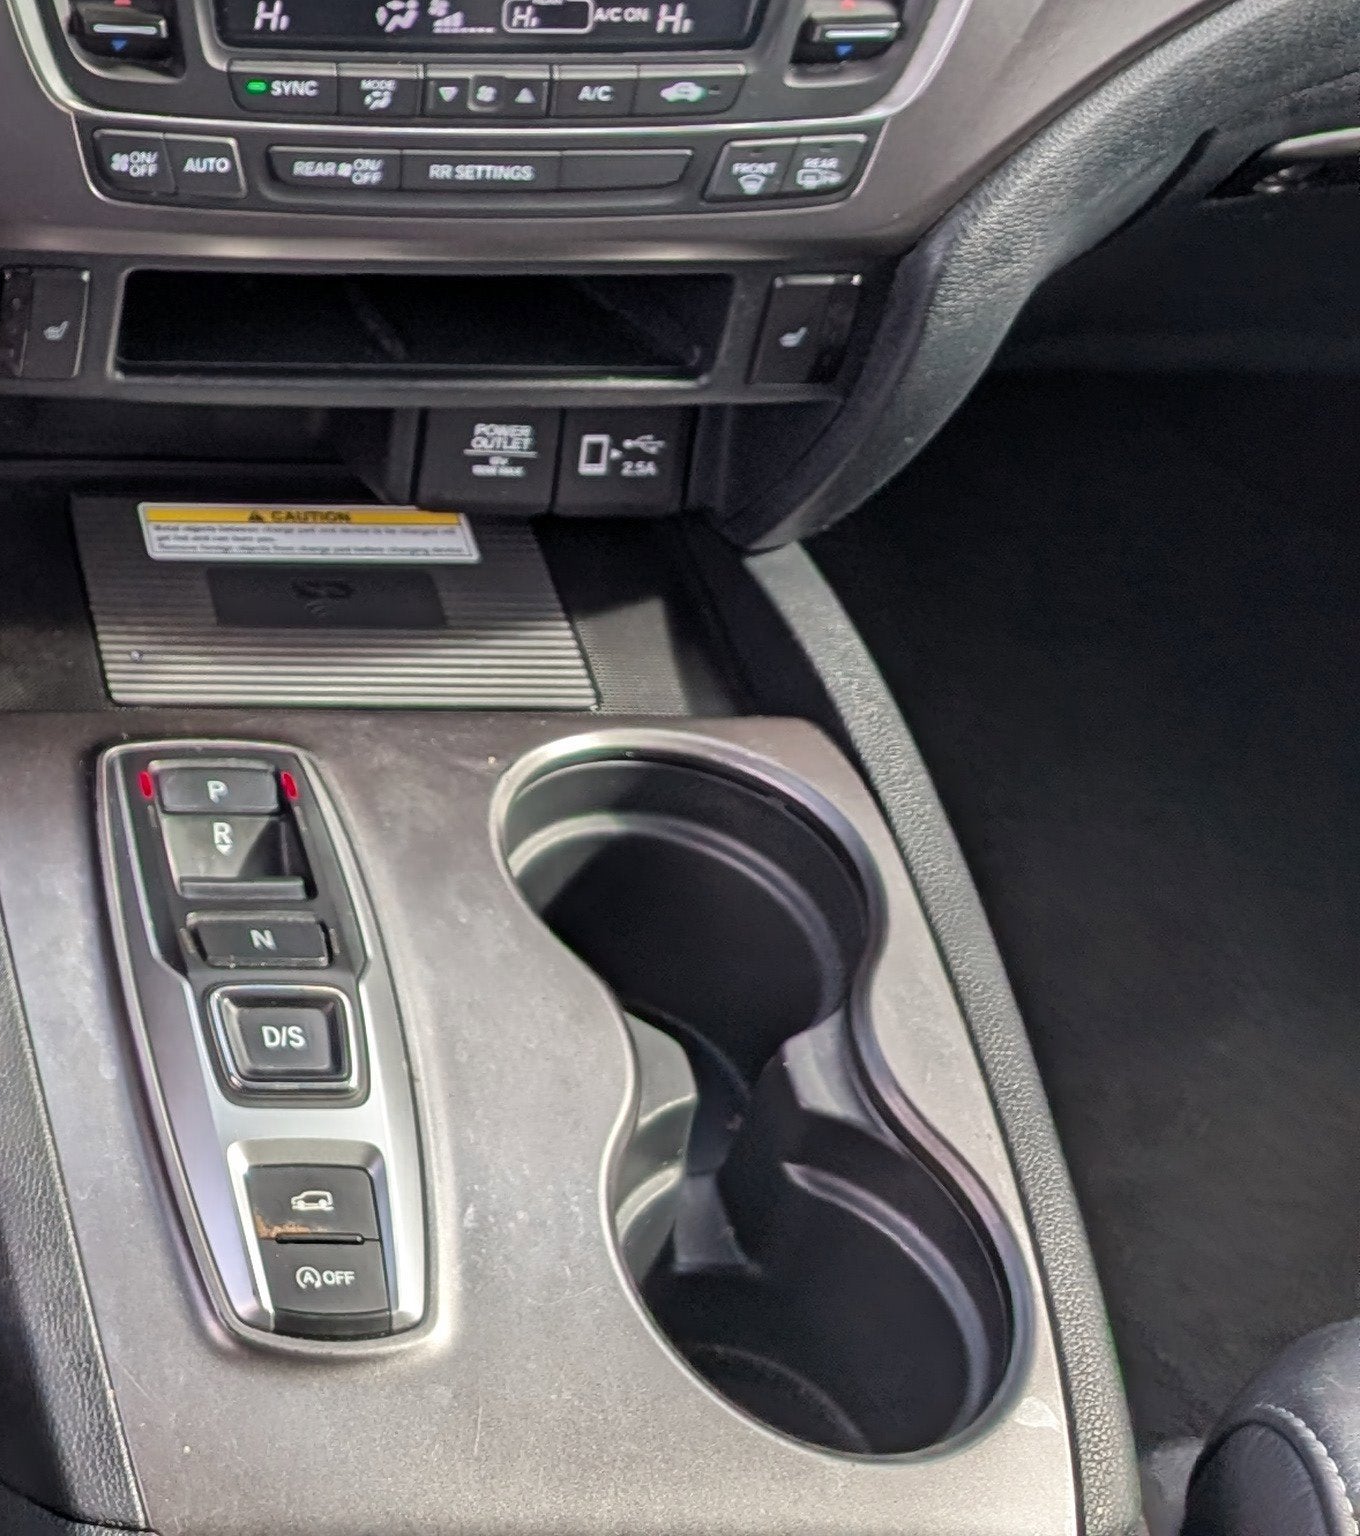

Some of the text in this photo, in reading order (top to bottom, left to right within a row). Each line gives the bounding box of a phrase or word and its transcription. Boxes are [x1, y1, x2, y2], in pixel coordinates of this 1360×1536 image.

[594, 7, 650, 22] A/C ON
[270, 79, 318, 97] SYNC
[360, 79, 398, 91] MODE
[578, 84, 614, 102] A/C
[182, 156, 230, 174] AUTO
[292, 161, 337, 177] REAR
[733, 161, 777, 175] FRONT
[803, 157, 839, 169] REAR
[129, 164, 158, 178] OFF
[351, 171, 383, 185] OFF
[428, 164, 535, 181] RR SETTINGS
[473, 423, 532, 437] POWER
[470, 436, 533, 450] OUTLET
[270, 510, 353, 524] CAUTION
[207, 780, 229, 803] P
[213, 822, 233, 844] R
[250, 929, 278, 951] N
[262, 1025, 306, 1049] D/S
[322, 1270, 355, 1285] OFF
